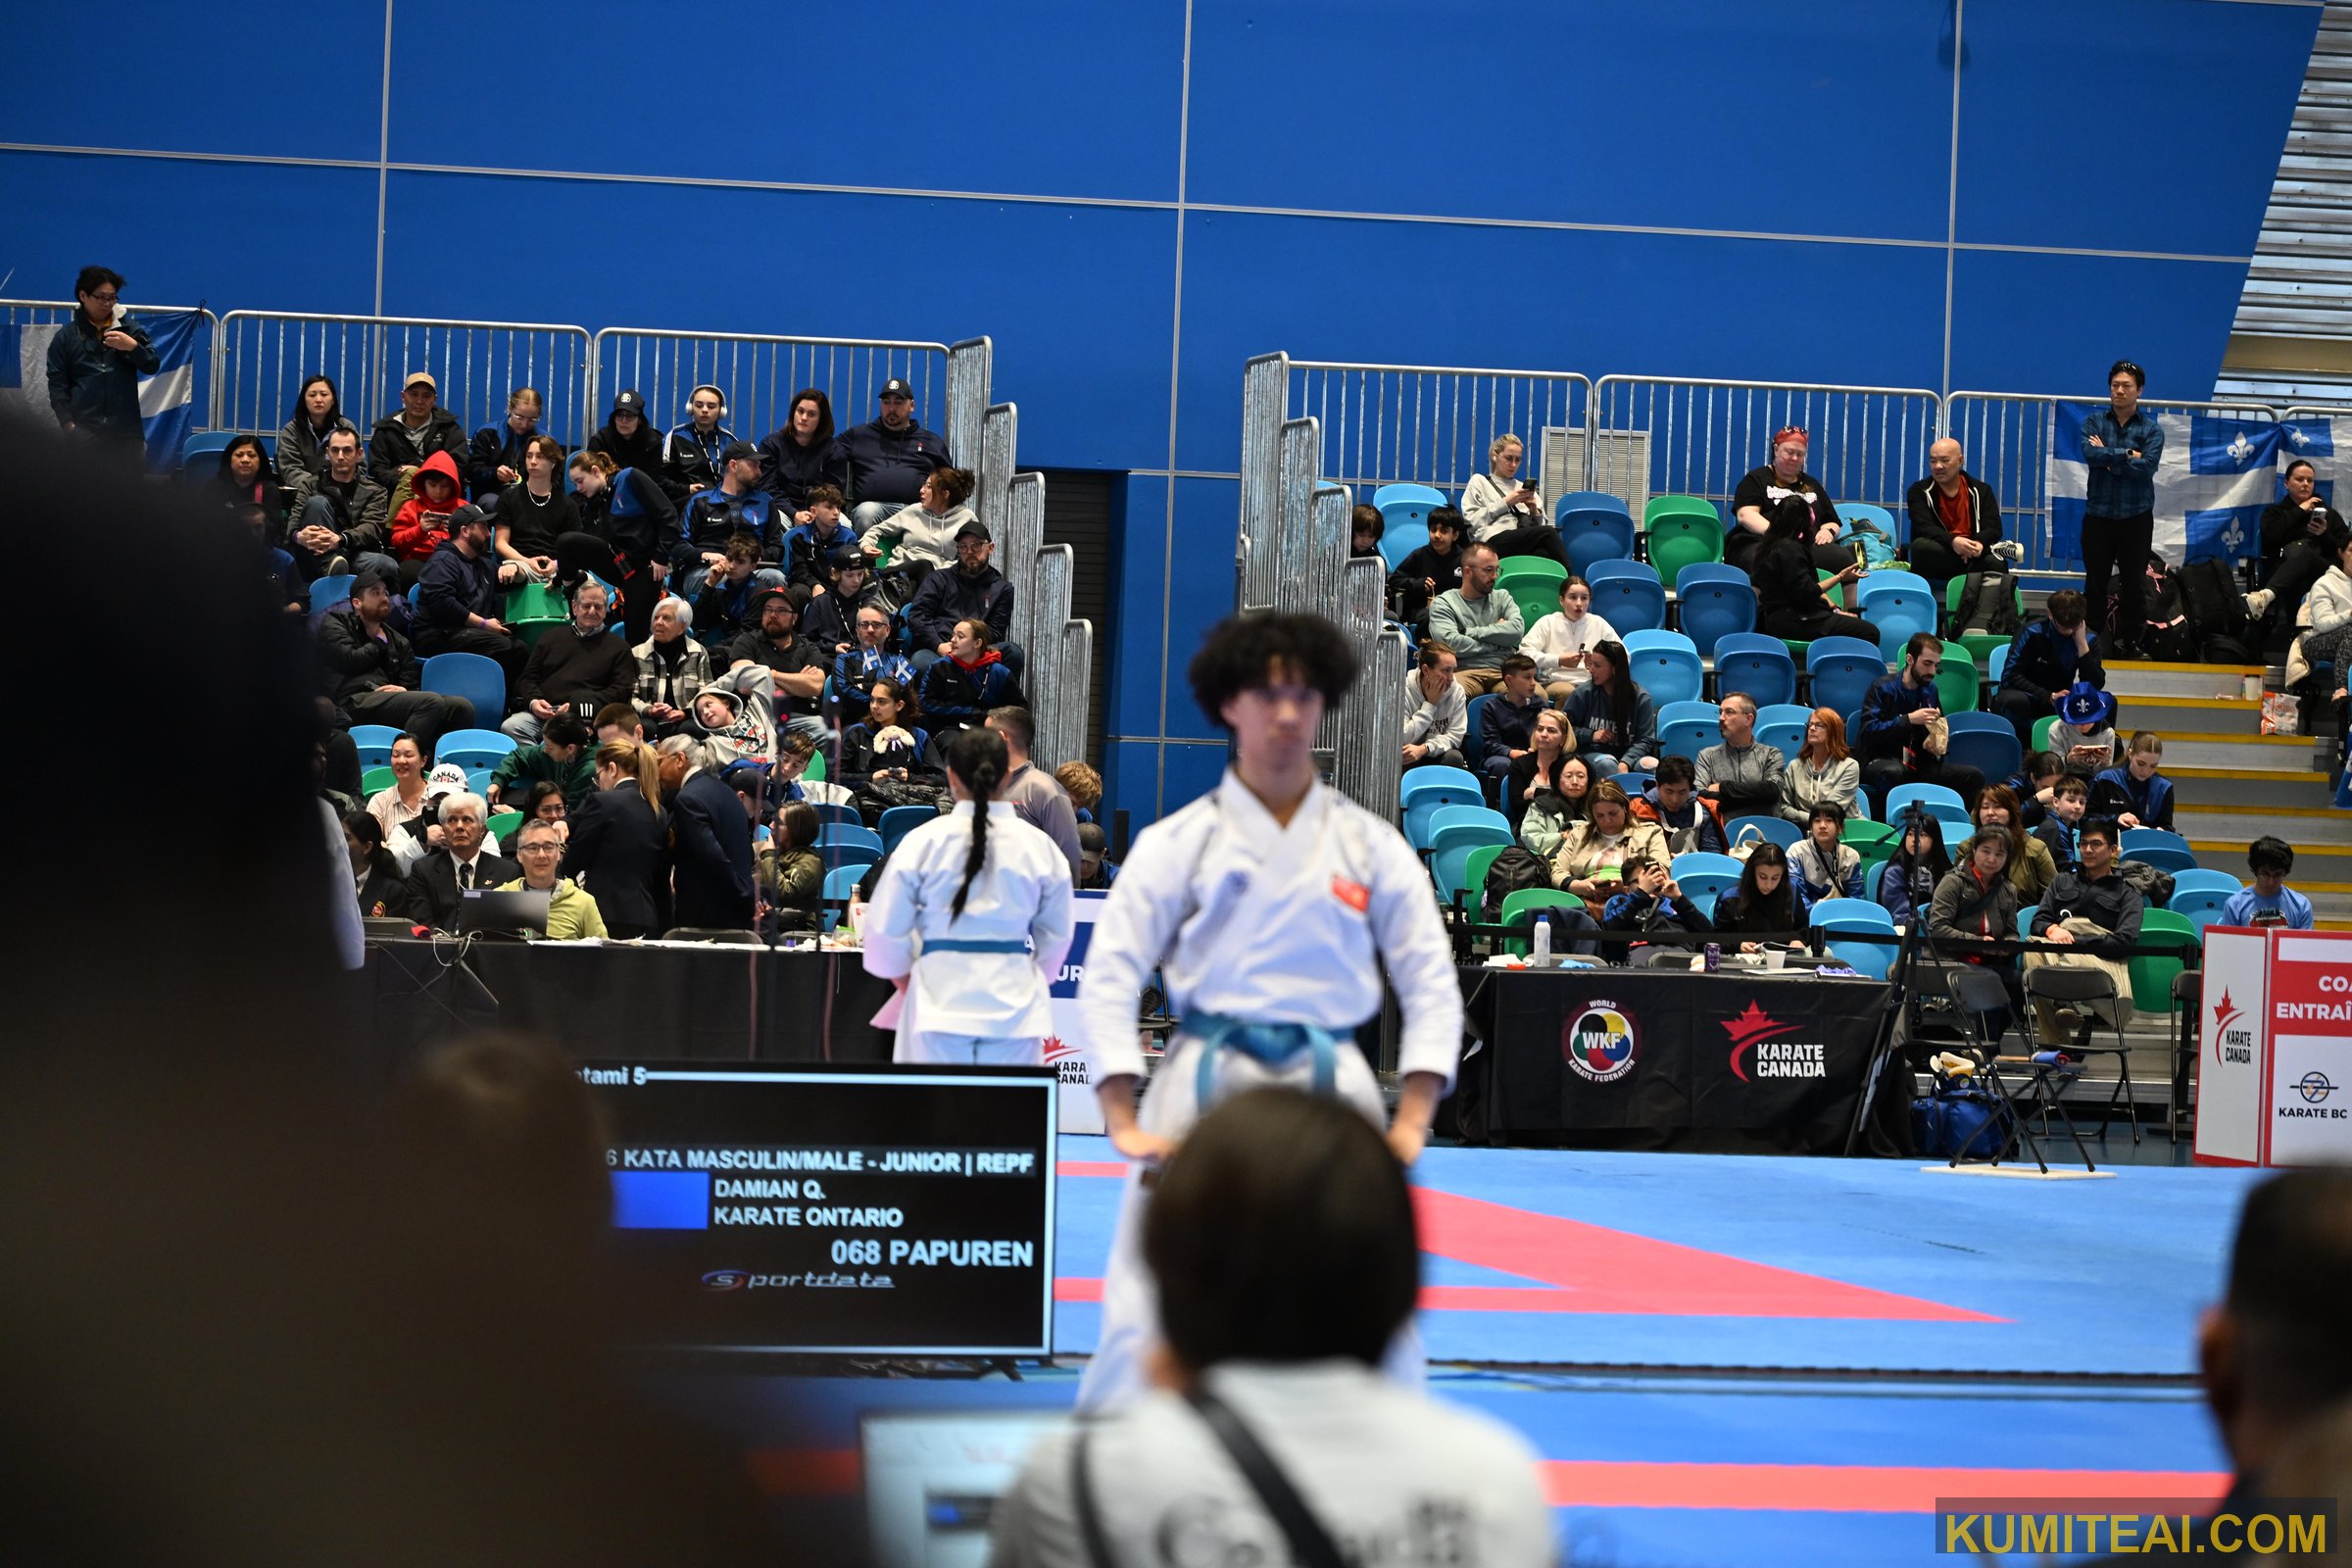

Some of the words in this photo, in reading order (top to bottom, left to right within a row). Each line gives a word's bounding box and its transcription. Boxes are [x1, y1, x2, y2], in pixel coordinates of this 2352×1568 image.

[433, 770, 460, 782] CANADA
[2318, 975, 2352, 993] CO
[1589, 1000, 1616, 1008] WORLD
[1582, 1032, 1621, 1050] WKF
[2226, 1029, 2251, 1048] KARATE
[1757, 1044, 1825, 1060] KARATE
[2225, 1047, 2251, 1064] CANADA
[633, 1065, 647, 1086] 5
[1054, 1061, 1090, 1073] KARA
[1568, 1058, 1593, 1080] KARATE
[1594, 1058, 1636, 1082] FEDERATION
[1757, 1060, 1826, 1078] CANADA
[2278, 1106, 2328, 1118] KARATE
[2330, 1108, 2348, 1119] BC
[623, 1149, 682, 1168] KATA
[687, 1150, 863, 1171] MASCULIN/MALE
[880, 1152, 961, 1173] JUNIOR
[714, 1179, 798, 1199] DAMIAN
[803, 1179, 826, 1200] Q.
[713, 1205, 802, 1226] KARATE
[806, 1206, 904, 1227] ONTARIO
[831, 1240, 882, 1265] 068
[889, 1240, 1034, 1267] PAPUREN
